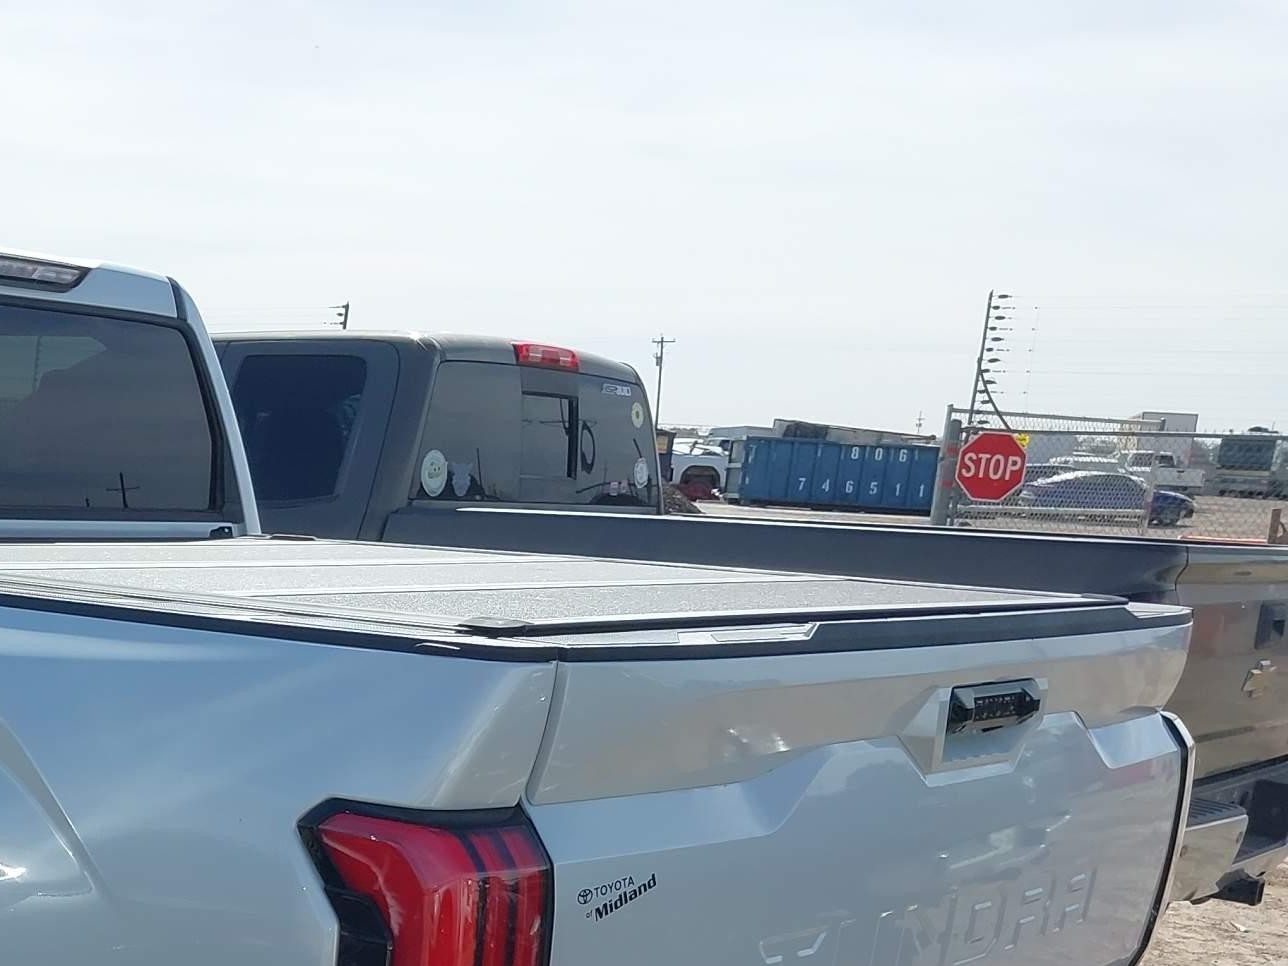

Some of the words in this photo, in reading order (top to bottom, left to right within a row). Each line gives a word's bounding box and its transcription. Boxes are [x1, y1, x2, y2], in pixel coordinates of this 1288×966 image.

[961, 452, 1022, 481] STOP
[593, 875, 635, 898] TOYOTA
[594, 872, 658, 922] Midland
